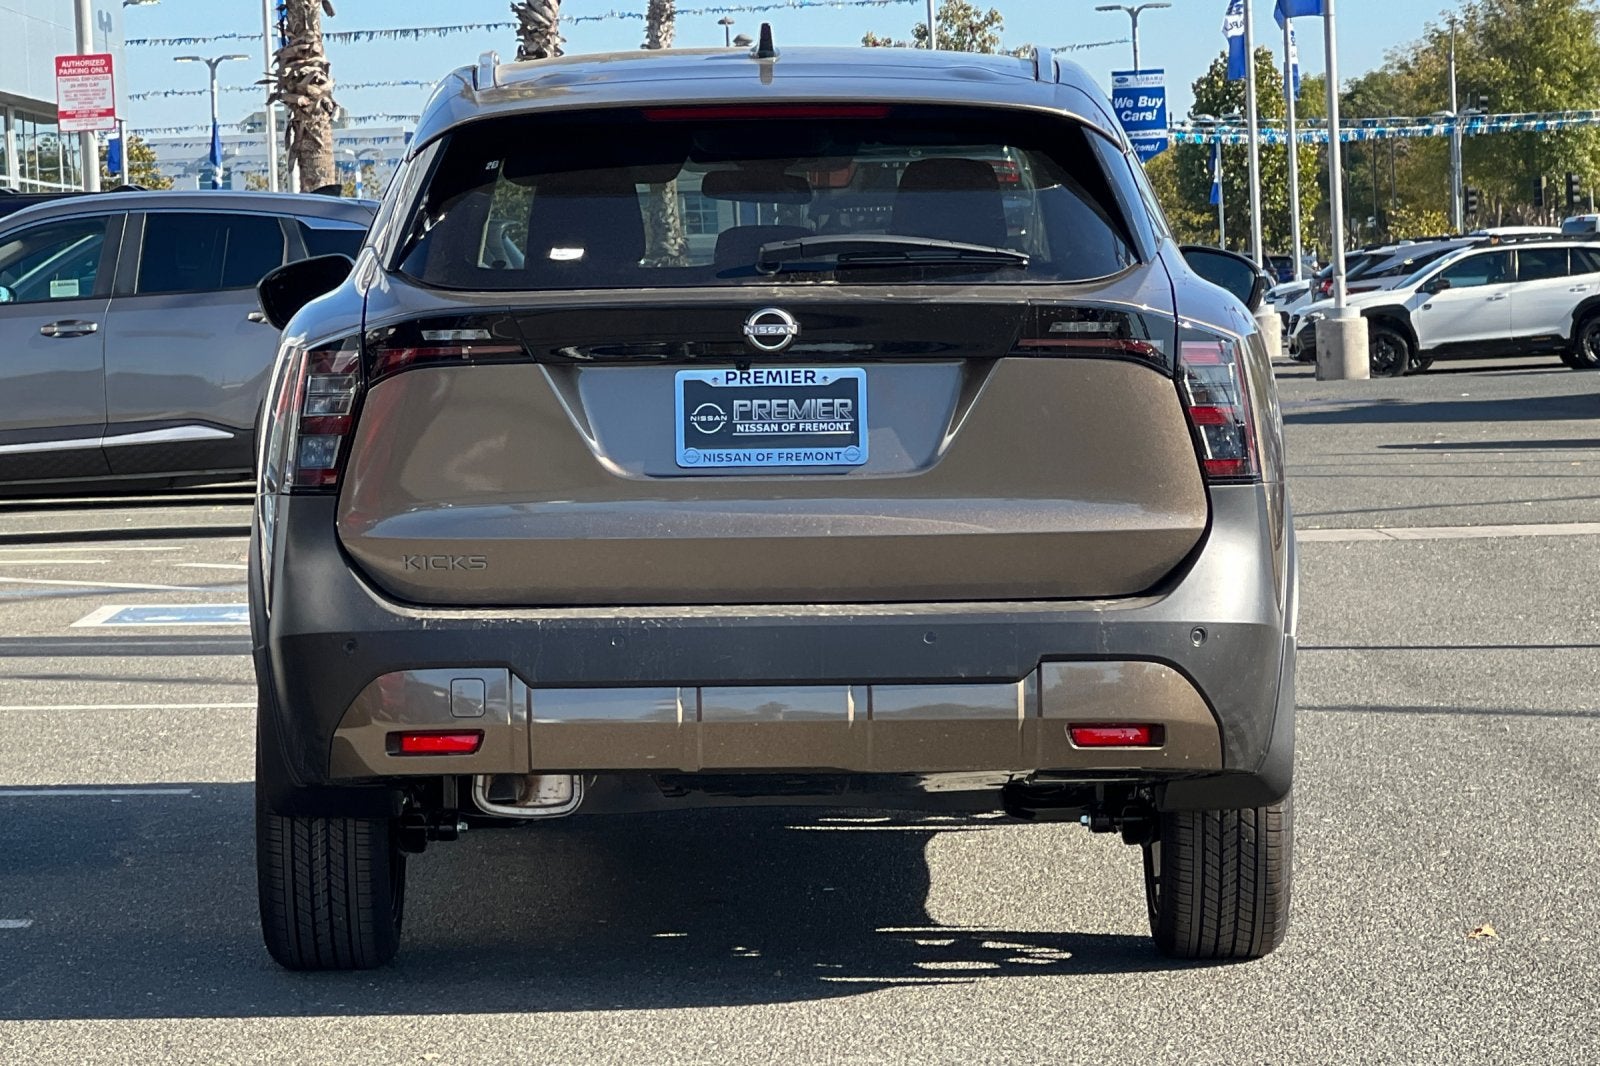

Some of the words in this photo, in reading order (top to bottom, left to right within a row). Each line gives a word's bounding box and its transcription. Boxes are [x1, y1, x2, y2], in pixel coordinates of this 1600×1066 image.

[61, 59, 106, 68] AUTHORIZED
[58, 67, 89, 76] PARKING
[90, 66, 109, 74] ONLY
[1114, 97, 1134, 109] We
[1137, 95, 1164, 109] Buy
[1121, 109, 1157, 121] Cars!
[744, 324, 797, 335] NISSAN
[725, 370, 816, 384] PREMIER
[733, 399, 853, 421] PREMIER
[736, 423, 778, 432] NISSAN
[782, 423, 796, 432] OF
[799, 422, 851, 431] FREMONT
[703, 453, 751, 462] NISSAN
[756, 452, 773, 462] OF
[777, 451, 842, 461] FREMONT
[402, 555, 488, 570] KICKS
